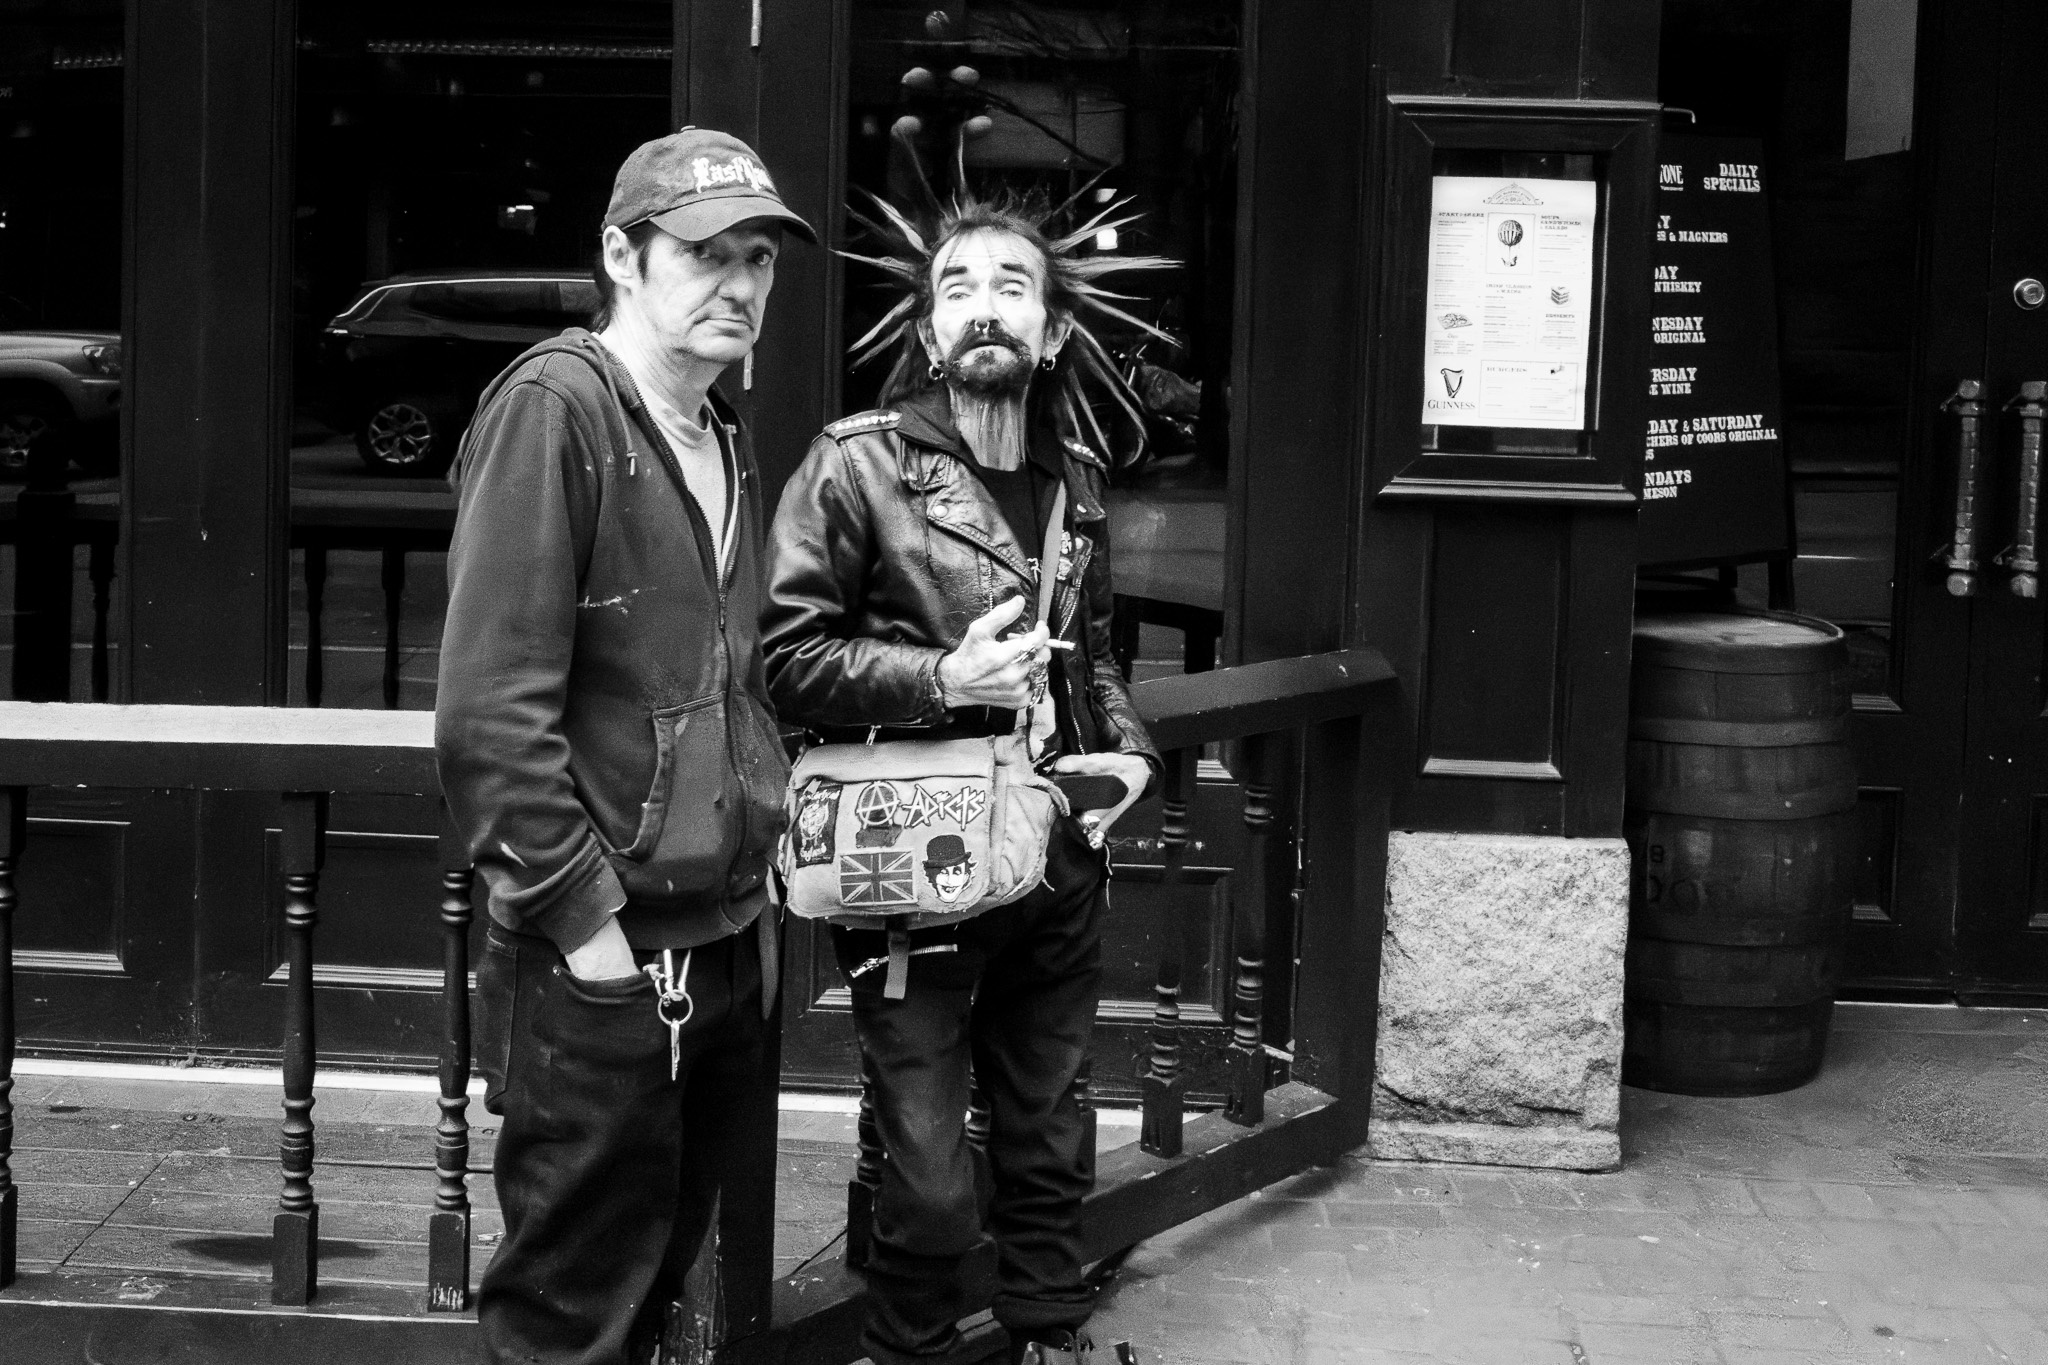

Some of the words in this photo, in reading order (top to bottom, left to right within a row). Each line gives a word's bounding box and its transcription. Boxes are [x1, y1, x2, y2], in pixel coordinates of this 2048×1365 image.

[1719, 164, 1758, 178] DAILY
[1704, 177, 1760, 192] SPECIALS
[1679, 231, 1728, 243] MAGNERS
[1654, 332, 1706, 343] ORIGINAL
[1661, 383, 1691, 395] WINE
[1647, 419, 1678, 434] DAY
[1683, 421, 1689, 432] &
[1692, 415, 1763, 431] SATURDAY
[1681, 434, 1694, 445] OF
[1697, 432, 1726, 444] COORS
[1728, 428, 1777, 441] ORIGINAL
[1645, 470, 1692, 486] NDAYS
